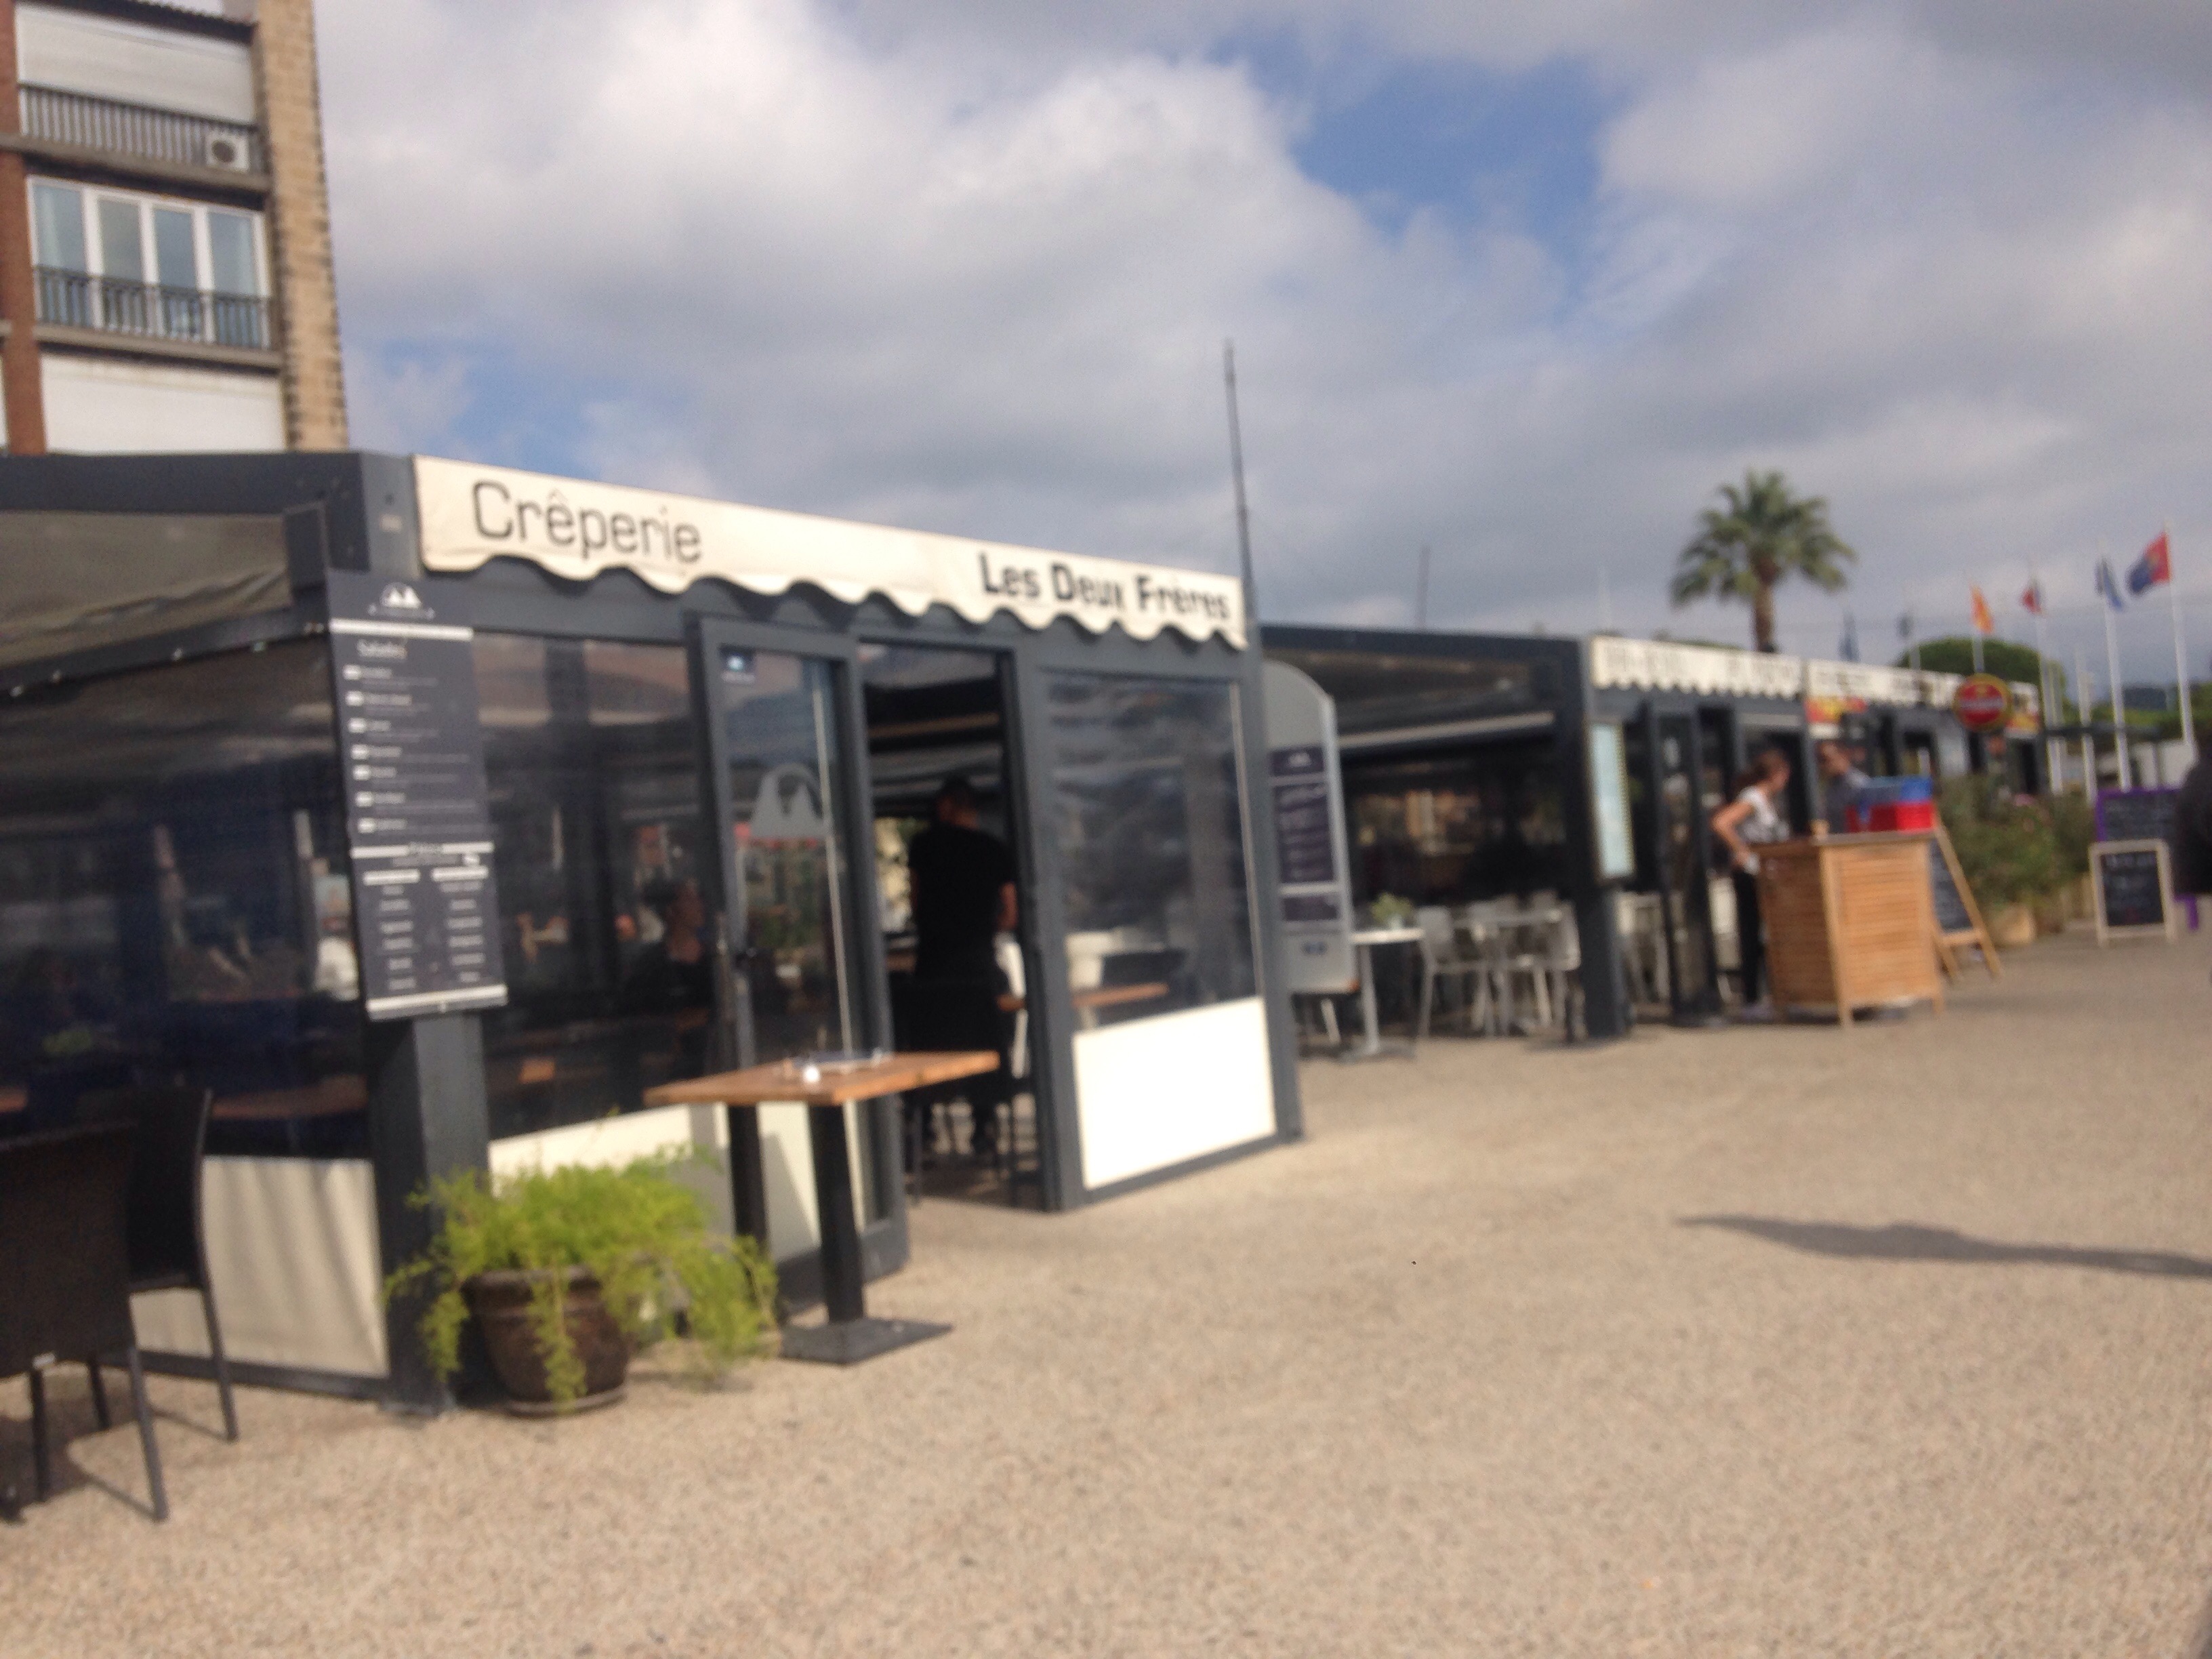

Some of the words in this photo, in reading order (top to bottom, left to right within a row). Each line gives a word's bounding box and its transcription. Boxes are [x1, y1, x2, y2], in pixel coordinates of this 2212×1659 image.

[472, 478, 702, 565] Crêperie
[979, 551, 1041, 598] Les
[1050, 562, 1126, 609] Deux
